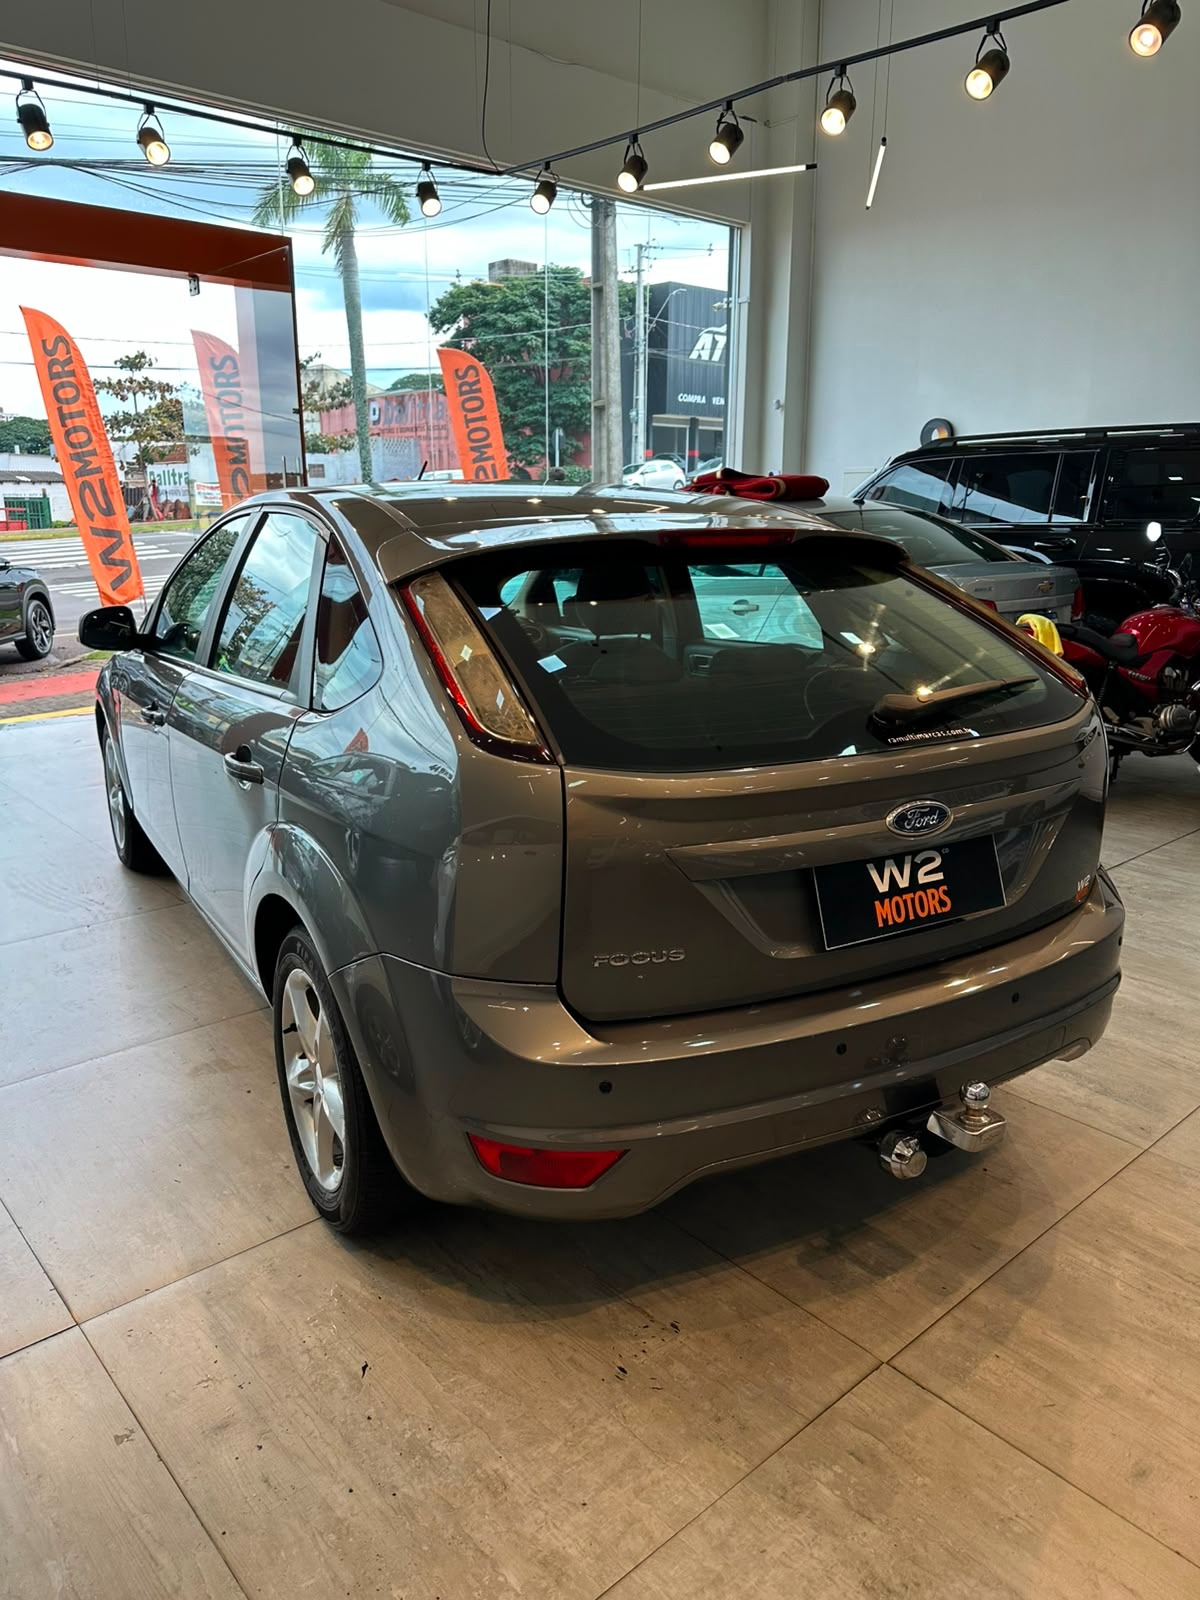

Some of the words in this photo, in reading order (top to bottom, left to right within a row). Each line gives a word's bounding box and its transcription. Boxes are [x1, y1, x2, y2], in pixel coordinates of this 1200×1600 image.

[677, 393, 706, 404] COMPRA
[904, 807, 940, 829] Ford
[866, 850, 944, 893] W2
[874, 885, 952, 928] MOTORS
[593, 949, 686, 968] FOCUS
